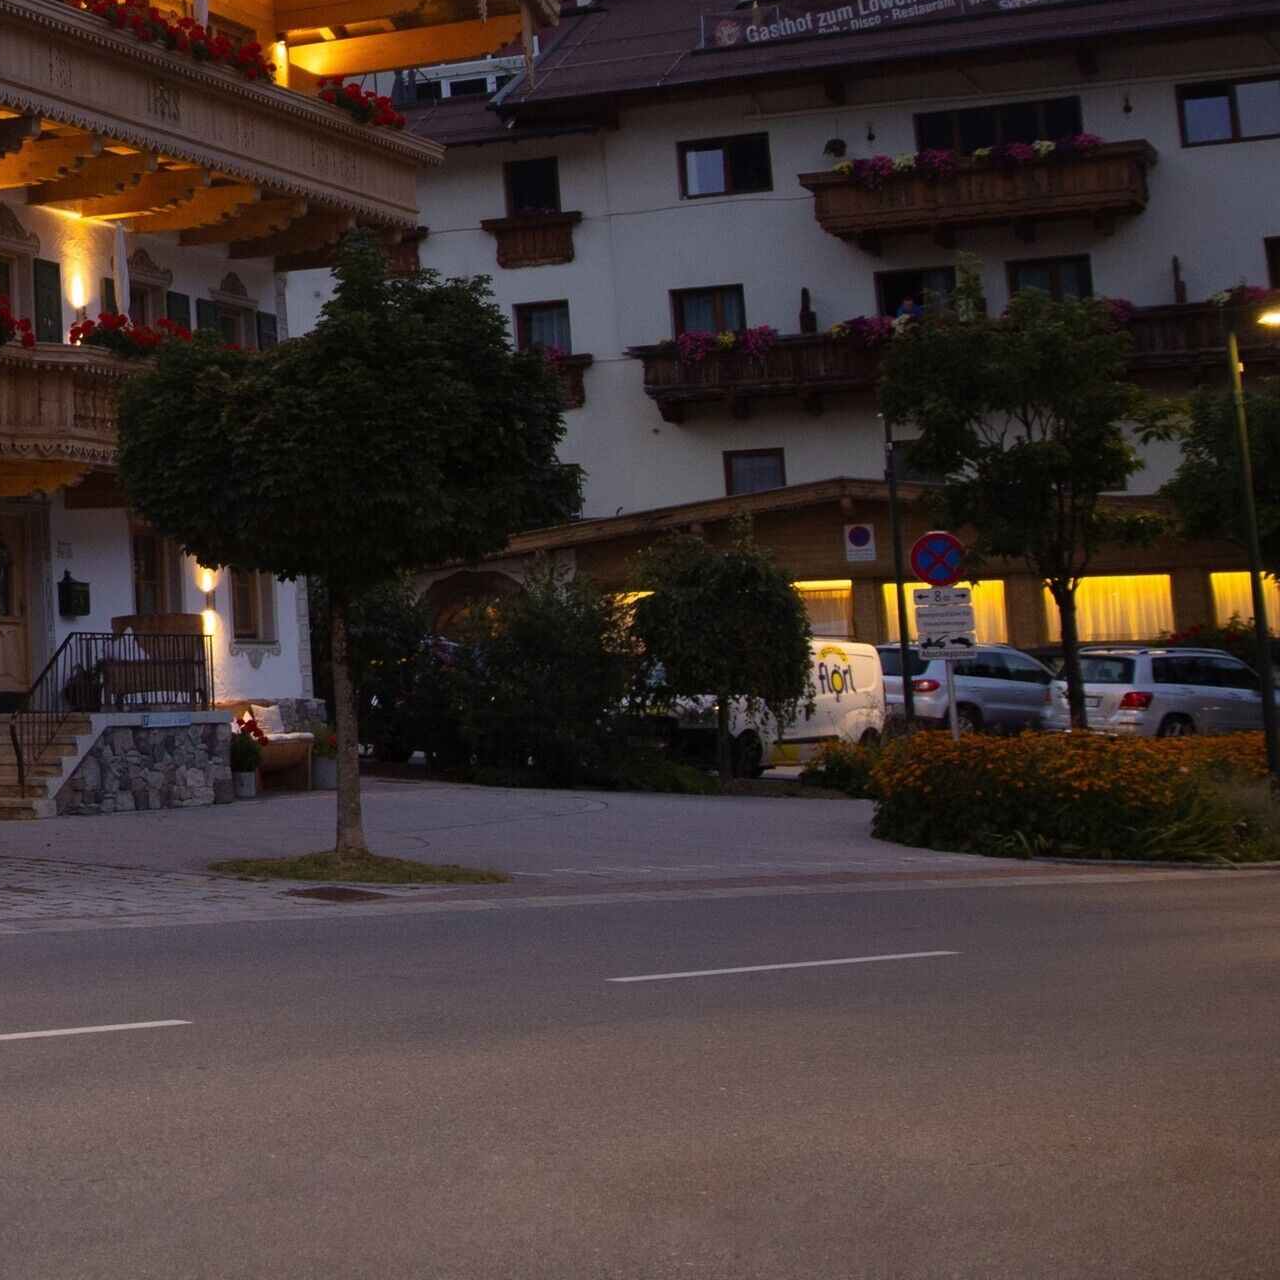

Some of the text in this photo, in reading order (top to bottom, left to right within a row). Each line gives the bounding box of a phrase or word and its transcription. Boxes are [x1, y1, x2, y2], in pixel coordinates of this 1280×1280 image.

[745, 12, 813, 43] Gasthof
[817, 6, 854, 27] zum
[850, 15, 882, 30] Disco
[934, 590, 942, 602] 8
